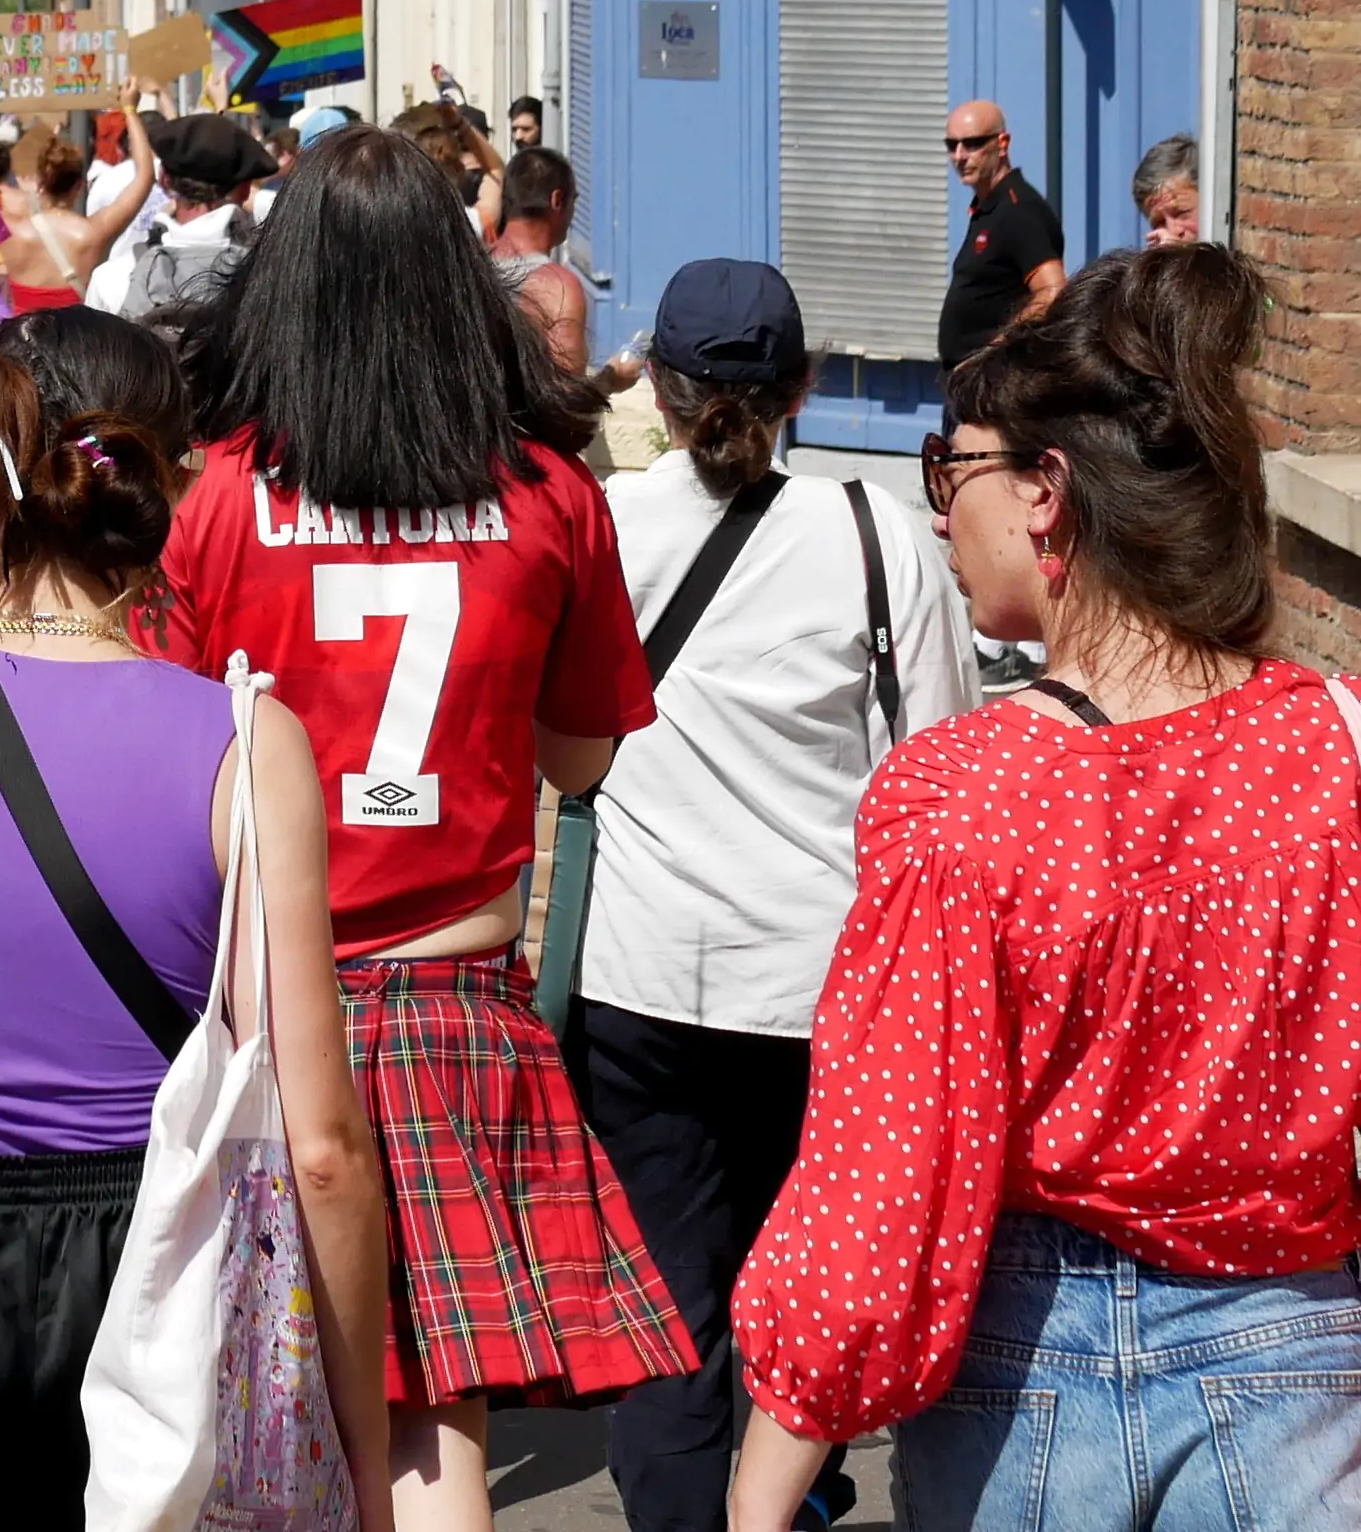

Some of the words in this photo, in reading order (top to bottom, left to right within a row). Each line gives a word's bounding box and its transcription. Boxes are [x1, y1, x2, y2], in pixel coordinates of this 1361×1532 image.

[57, 29, 118, 54] MADE
[877, 626, 888, 654] EOS
[313, 561, 461, 826] 7
[362, 806, 418, 817] UMBRO
